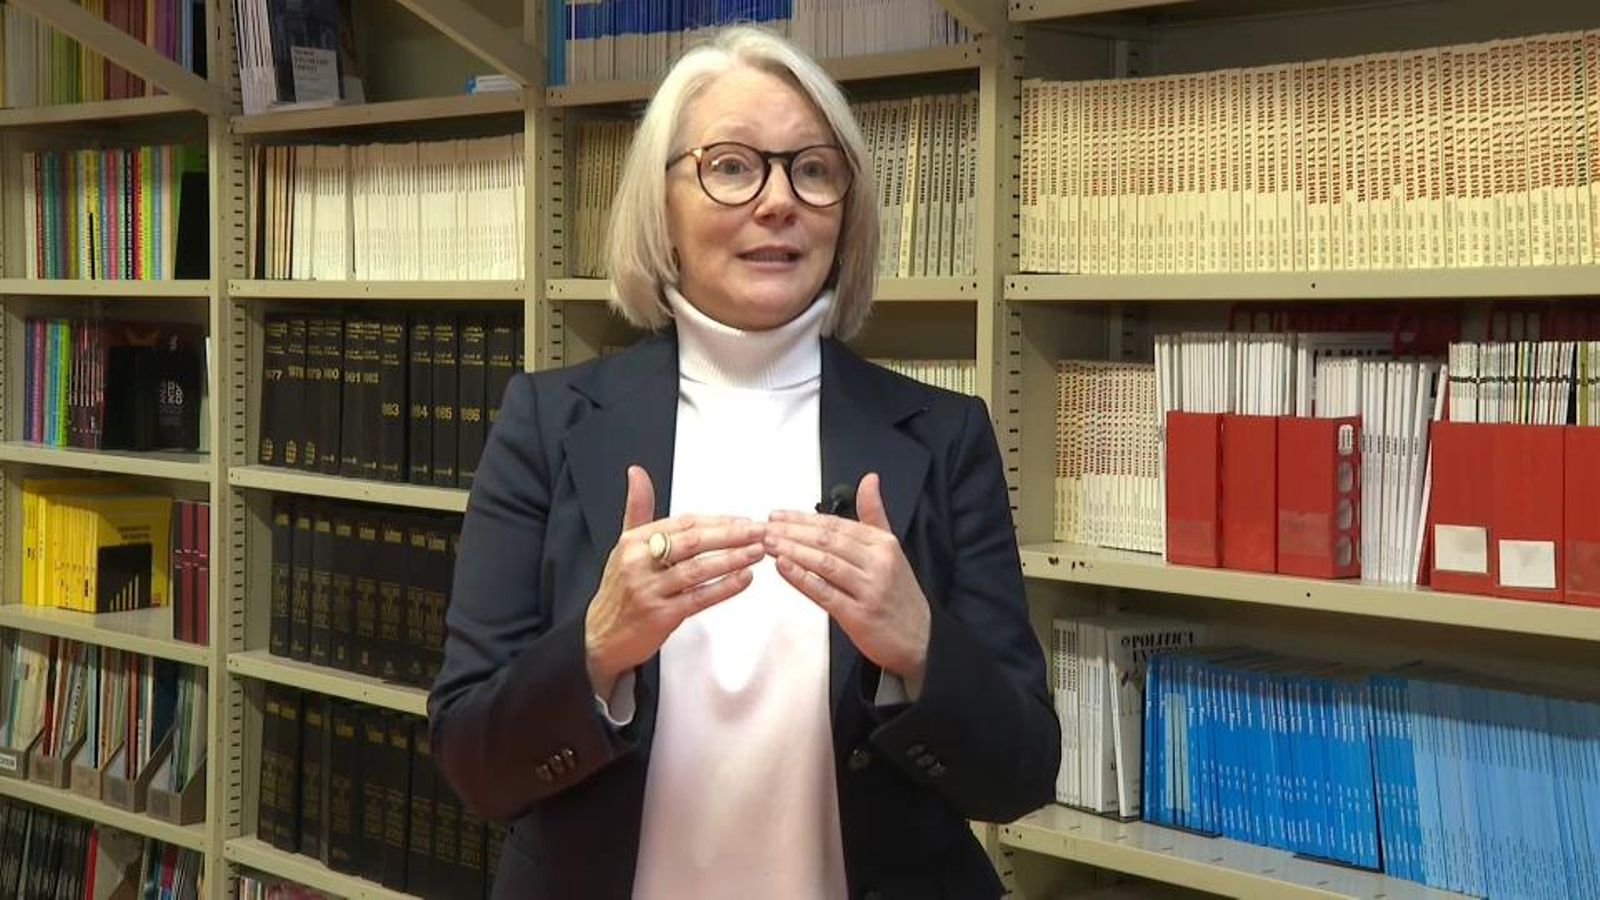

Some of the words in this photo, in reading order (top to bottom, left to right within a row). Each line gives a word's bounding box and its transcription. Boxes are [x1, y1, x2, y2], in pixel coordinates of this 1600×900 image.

[1306, 68, 1315, 134] ECONOMIA
[1317, 66, 1326, 133] ECONOMIA
[1330, 66, 1339, 133] ECONOMIA
[1343, 66, 1353, 126] ECONOMIA
[1354, 63, 1364, 131] ECONOMIA
[1366, 60, 1377, 128] ECONOMIA
[1378, 60, 1389, 128] ECONOMIA
[1388, 58, 1400, 120] ECONOMIA
[1402, 59, 1413, 128] ECONOMIA
[1413, 55, 1424, 124] ECONOMIA
[1427, 57, 1438, 127] ECONOMIA
[1441, 52, 1452, 122] ECONOMIA
[1453, 54, 1465, 123] ECONOMIA
[1466, 53, 1477, 123] ECONOMIA
[1478, 53, 1489, 123] ECONOMIA
[1489, 47, 1501, 118] ECONOMIA
[1501, 46, 1512, 117] ECONOMIA
[1512, 44, 1524, 116] ECONOMIA
[1526, 40, 1538, 113] ECONOMIA
[1537, 41, 1549, 112] ECONOMIA
[1548, 41, 1561, 113] ECONOMIA
[1559, 40, 1572, 111] ECONOMIA
[1572, 39, 1584, 110] ECONOMIA
[1585, 35, 1598, 106] ECONOMIA
[1307, 138, 1315, 204] EXTERIOR
[1318, 137, 1327, 203] EXTERIOR
[1331, 137, 1340, 204] EXTERIOR
[1344, 130, 1354, 190] EXTERIOR
[1355, 134, 1366, 202] EXTERIOR
[1368, 132, 1379, 200] EXTERIOR
[1379, 132, 1390, 200] EXTERIOR
[1390, 123, 1401, 185] EXTERIOR
[1404, 132, 1415, 200] EXTERIOR
[1415, 128, 1427, 198] EXTERIOR
[1428, 130, 1440, 200] EXTERIOR
[1443, 125, 1454, 195] EXTERIOR
[1455, 127, 1467, 198] EXTERIOR
[1468, 127, 1479, 197] EXTERIOR
[1480, 127, 1491, 198] EXTERIOR
[1492, 122, 1503, 195] EXTERIOR
[1503, 121, 1515, 193] EXTERIOR
[1514, 120, 1526, 193] EXTERIOR
[1528, 117, 1540, 189] EXTERIOR
[1539, 115, 1551, 187] EXTERIOR
[1551, 116, 1563, 188] EXTERIOR
[1562, 115, 1575, 187] EXTERIOR
[1575, 115, 1587, 186] EXTERIOR
[1588, 110, 1600, 183] EXTERIOR
